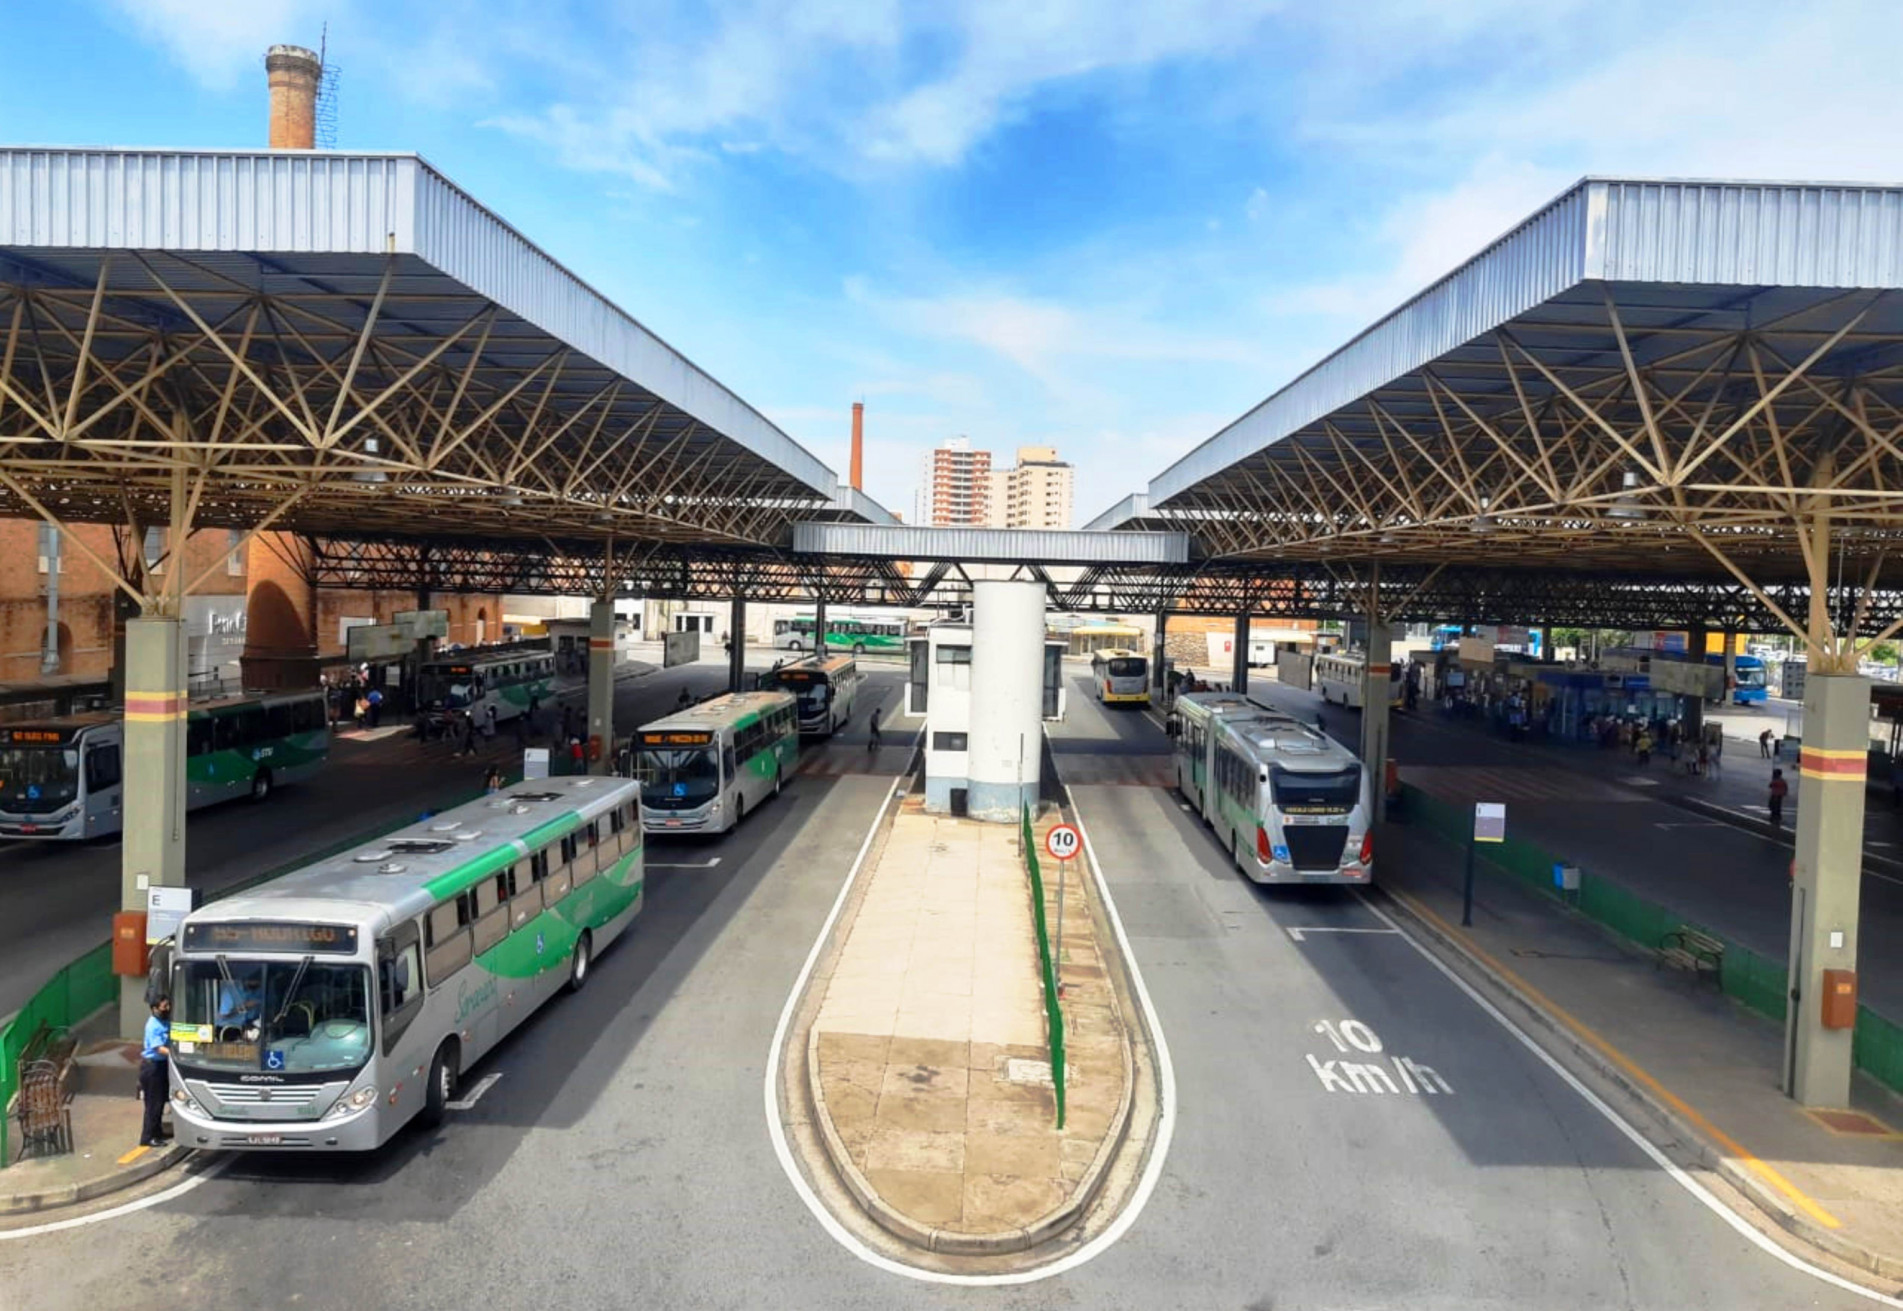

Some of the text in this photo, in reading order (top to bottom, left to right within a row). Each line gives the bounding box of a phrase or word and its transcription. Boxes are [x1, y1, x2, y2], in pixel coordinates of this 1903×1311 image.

[1053, 832, 1074, 847] 10
[152, 894, 161, 906] E
[1314, 1019, 1384, 1053] 10
[1305, 1053, 1456, 1095] km/h
